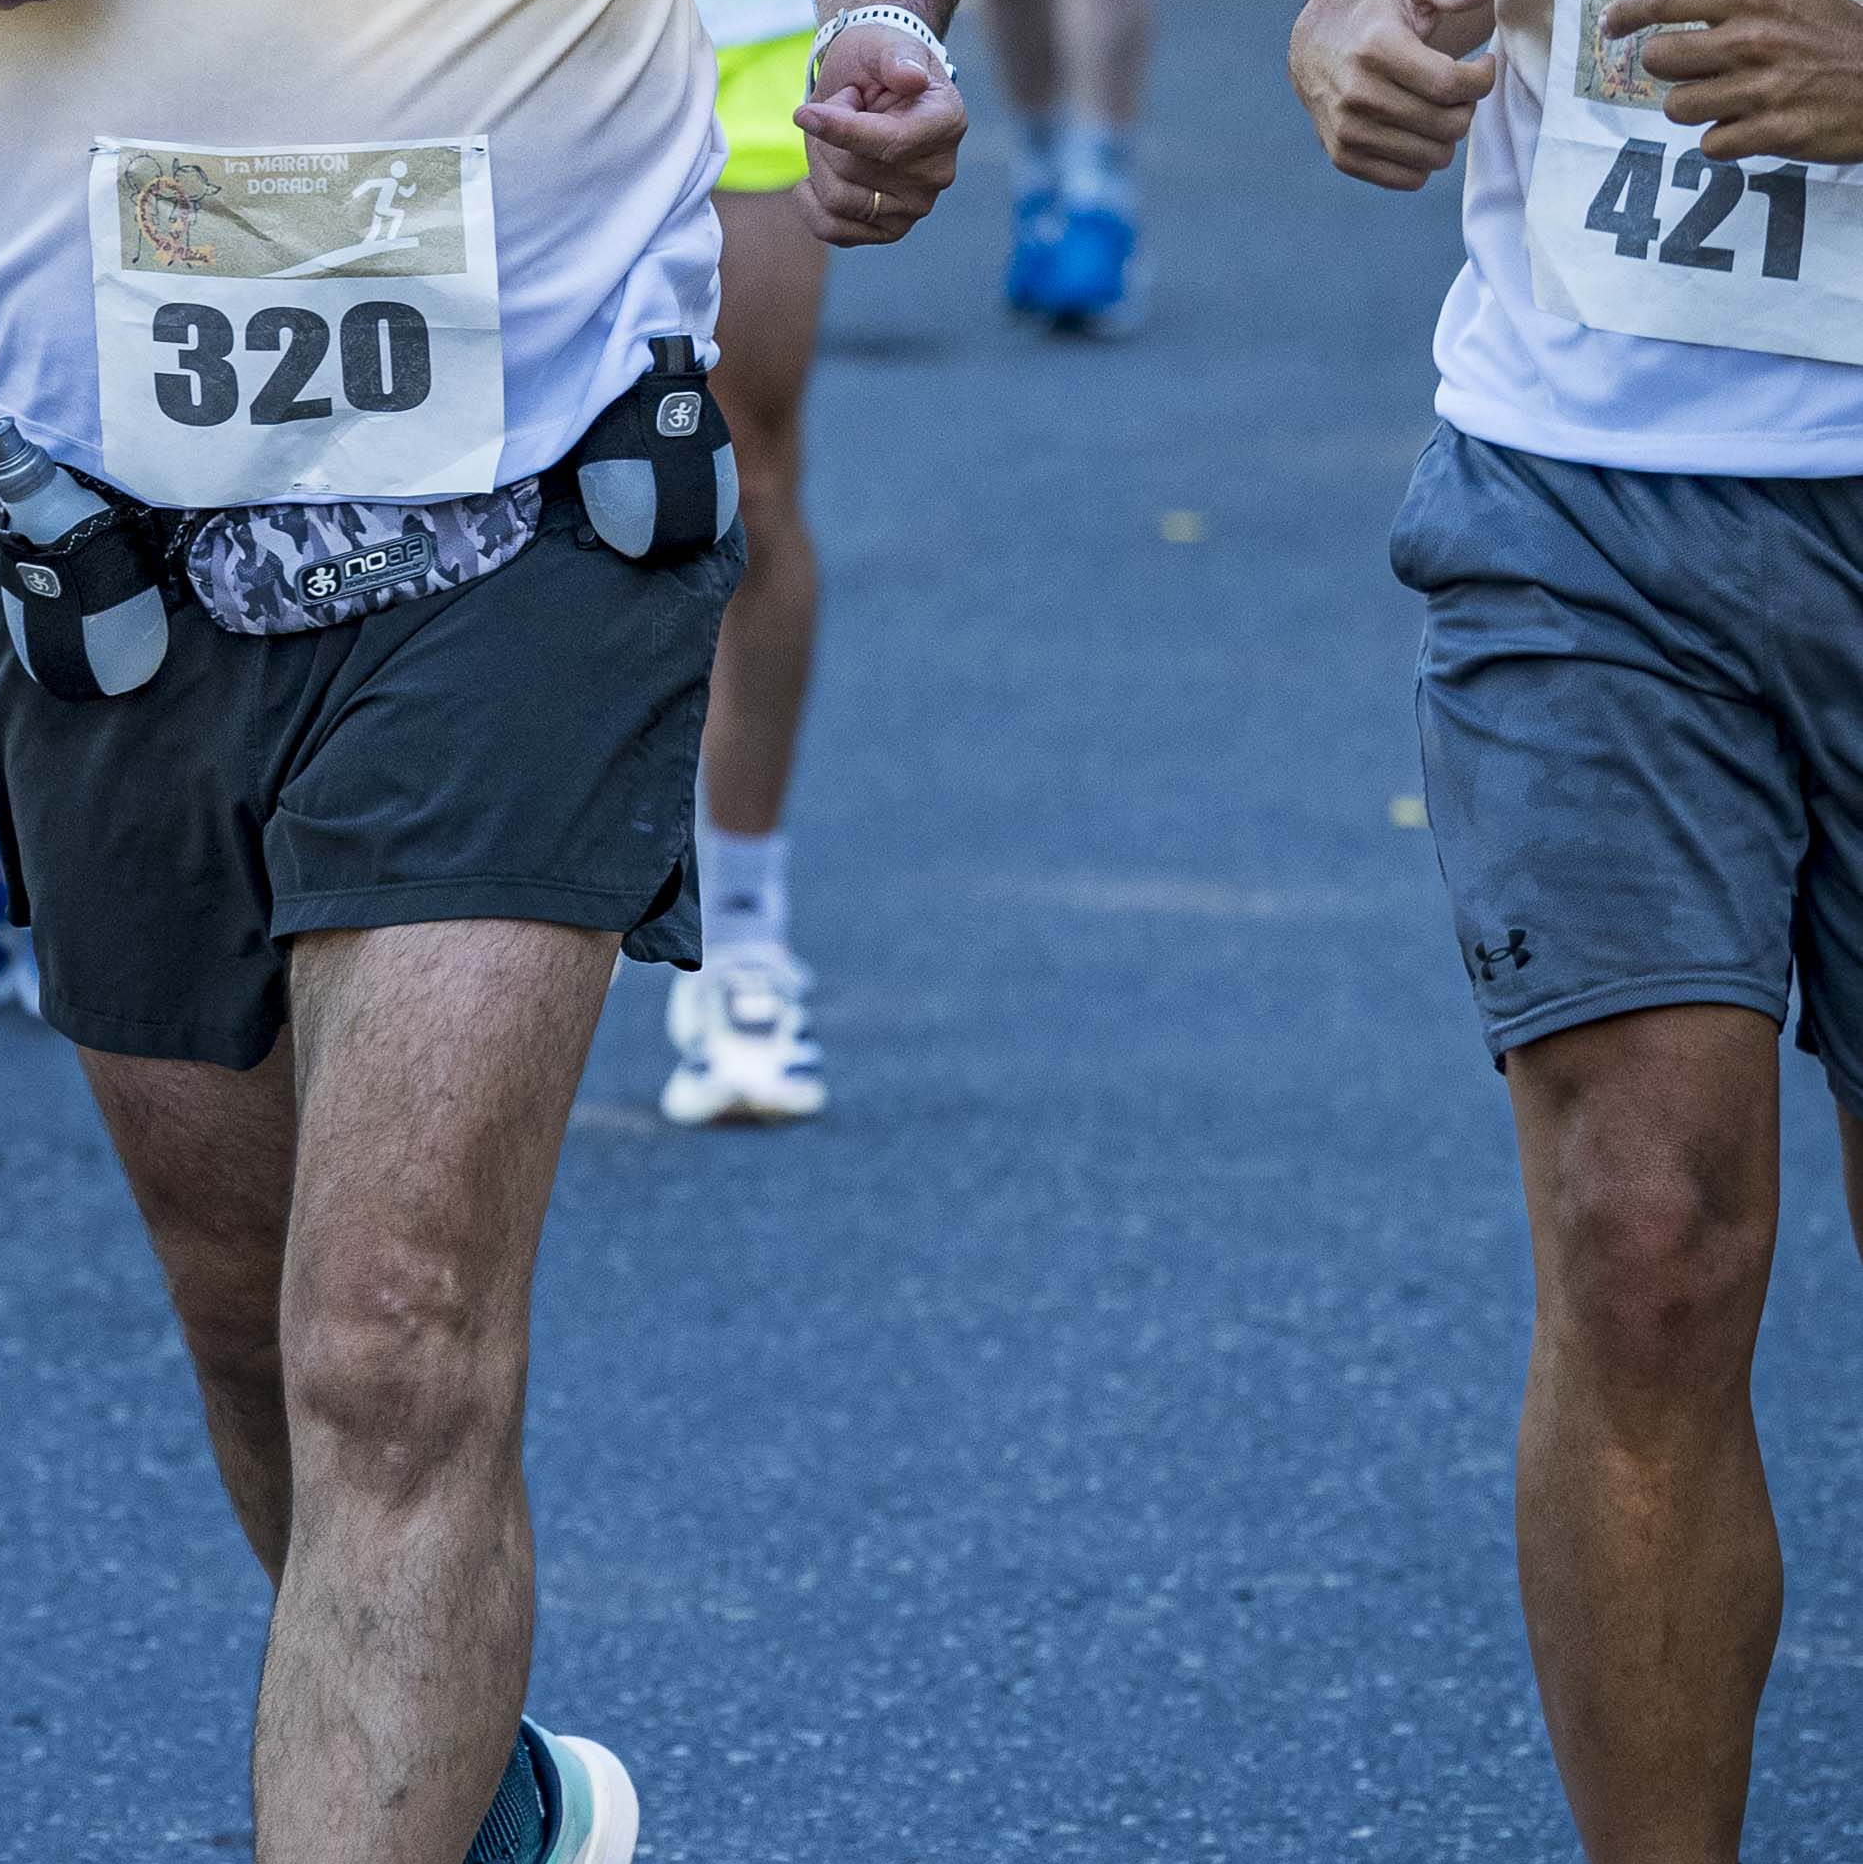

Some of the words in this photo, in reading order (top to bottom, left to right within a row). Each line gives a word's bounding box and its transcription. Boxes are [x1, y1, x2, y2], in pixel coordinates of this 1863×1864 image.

[247, 177, 328, 195] DORADA
[1584, 137, 1809, 281] 421
[152, 300, 432, 427] 320
